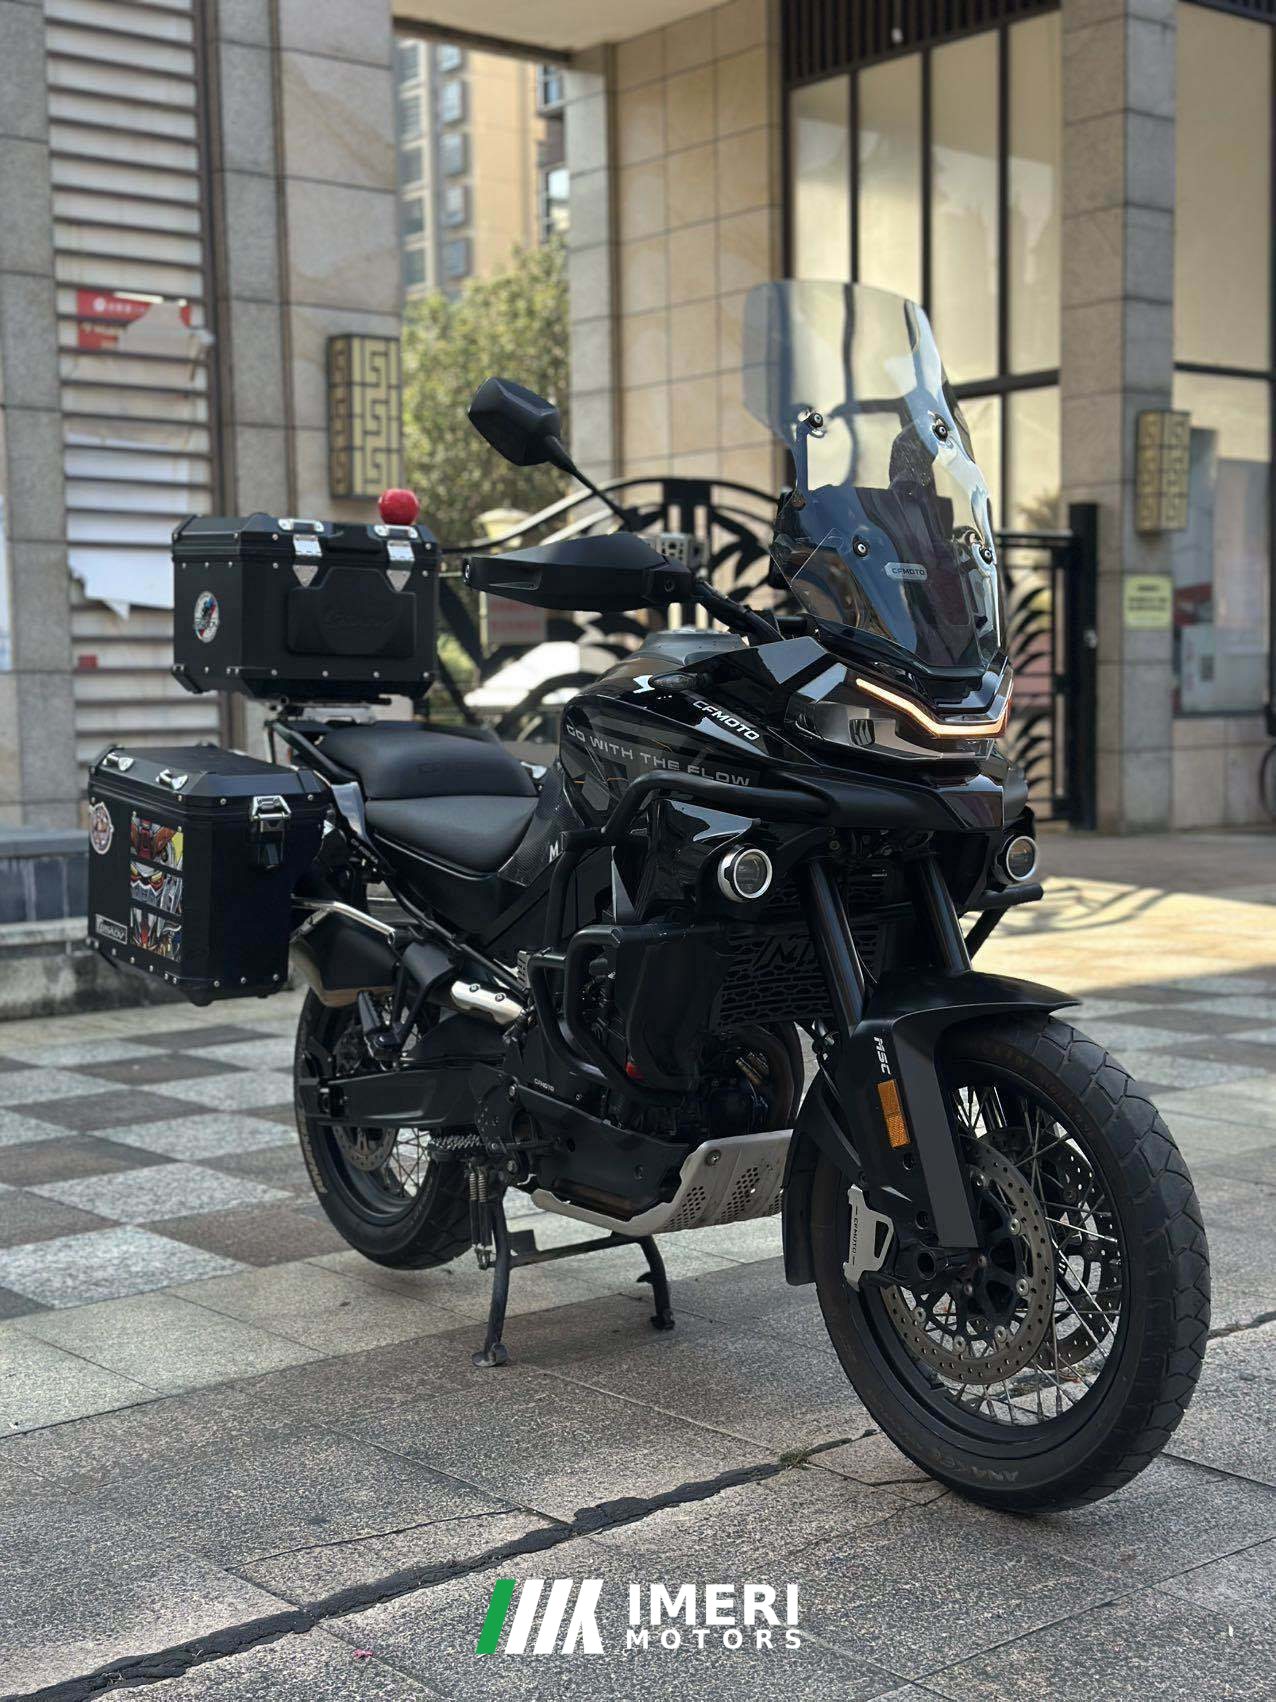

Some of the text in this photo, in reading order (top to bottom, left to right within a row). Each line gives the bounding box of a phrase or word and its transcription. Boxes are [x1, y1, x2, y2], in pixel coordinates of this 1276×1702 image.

[891, 567, 926, 576] CFMOTO
[692, 700, 760, 741] CFMOTO
[566, 724, 750, 786] GO WITH THE FLOW
[873, 1036, 891, 1075] MSC
